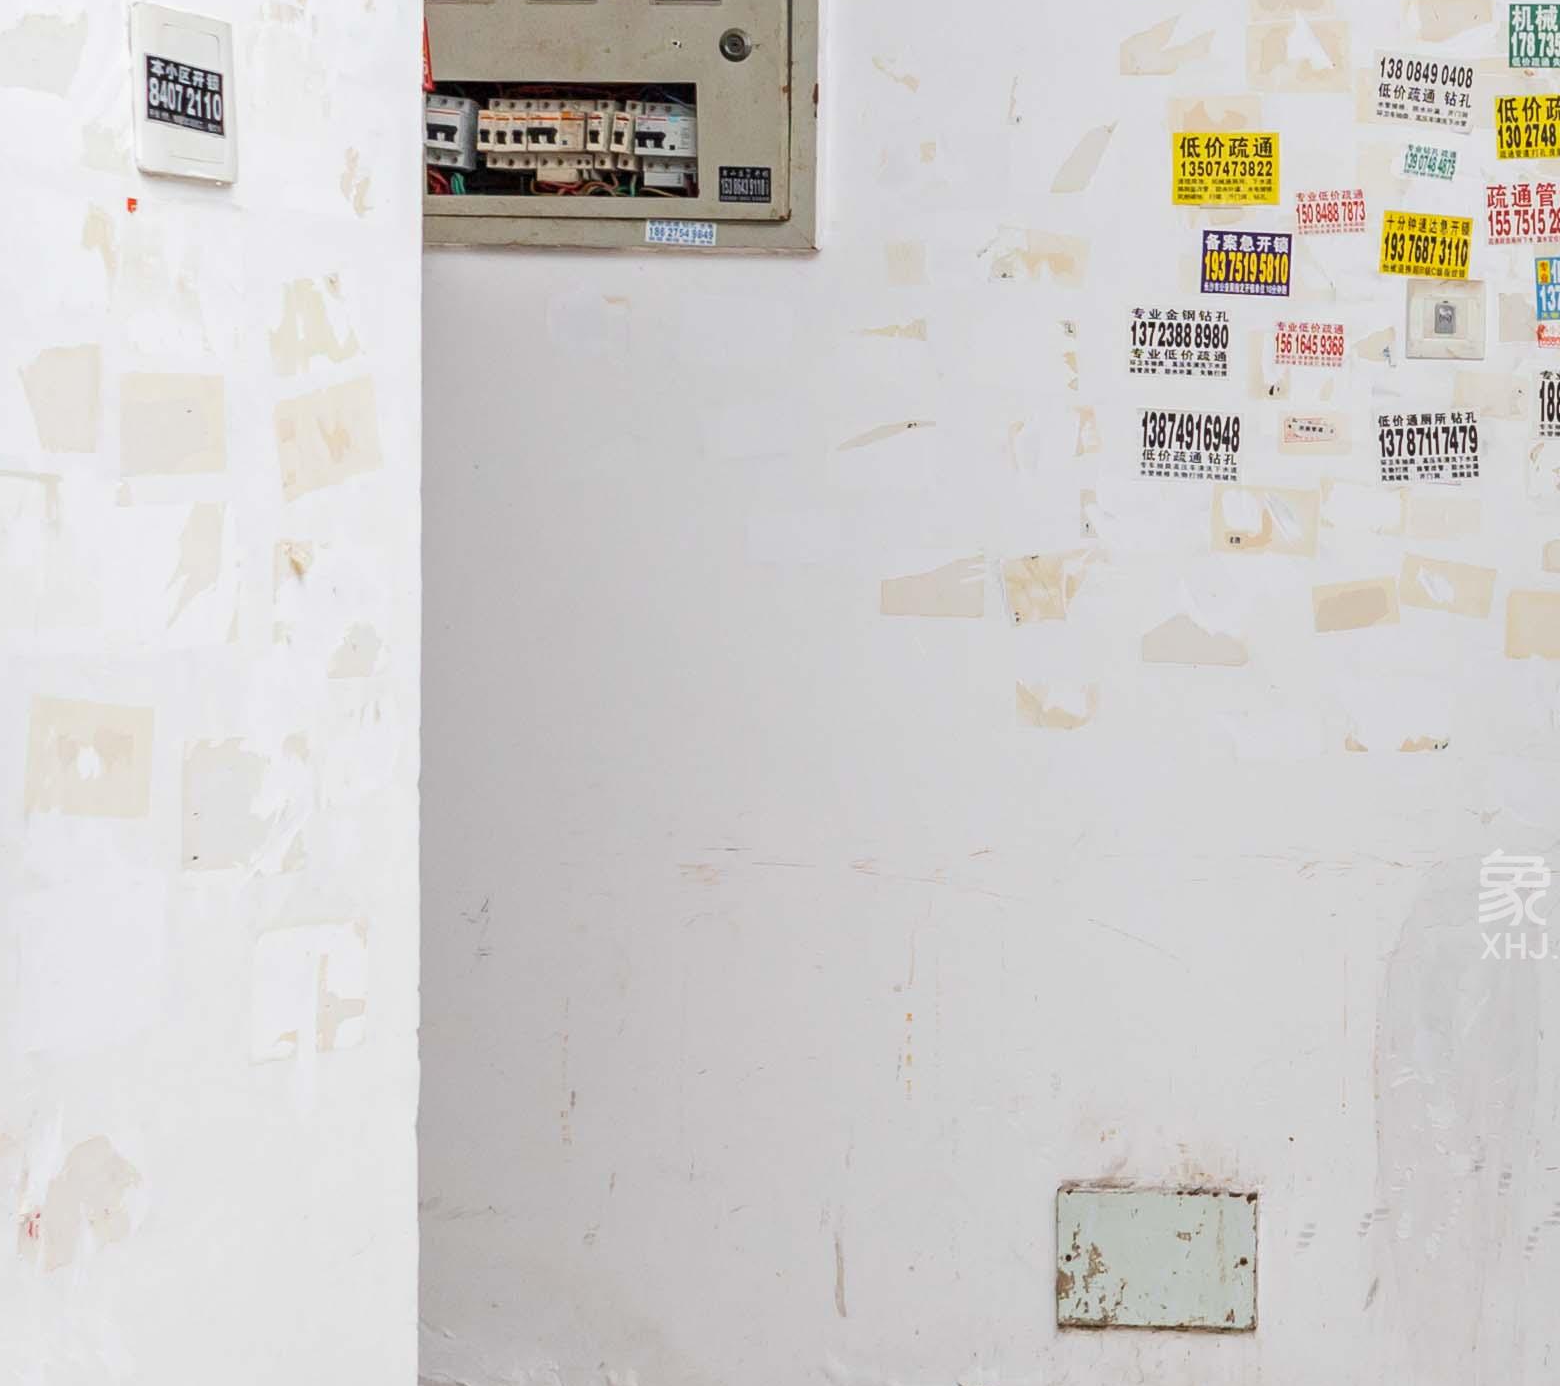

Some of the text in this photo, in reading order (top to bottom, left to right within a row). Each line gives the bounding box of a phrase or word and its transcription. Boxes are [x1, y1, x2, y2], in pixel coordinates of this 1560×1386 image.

[1510, 32, 1536, 58] 178
[149, 59, 220, 92] 本小区开锁
[1379, 57, 1474, 89] 138 0849 0408
[148, 76, 223, 122] 8407 2110
[1378, 82, 1472, 110] 低价疏通 钻孔
[1179, 136, 1274, 159] 低价疏通
[1497, 125, 1522, 149] 130
[1524, 123, 1557, 148] 2748
[1180, 160, 1274, 177] 13507473822
[1295, 188, 1365, 202] 专业低价疏通
[1295, 200, 1366, 224] 150 8488 7873
[1487, 209, 1511, 237] 155
[1514, 208, 1547, 236] 7515
[1205, 233, 1290, 254] 备案急开锁
[1383, 231, 1469, 268] 193 7687 3110
[1204, 251, 1289, 284] 193 7519 5810
[1131, 307, 1230, 322] 专业金钢钻孔
[1130, 321, 1230, 350] 137 2388 8980
[1276, 321, 1345, 335] 专业低价疏通
[1130, 348, 1228, 362] 专业低价疏通
[1274, 332, 1345, 357] 156 1645 9368
[1378, 411, 1478, 427] 低价通厕所 钻孔
[1142, 411, 1240, 454] 13874916948
[1379, 427, 1405, 458] 137
[1142, 449, 1237, 466] 低价疏通 钻孔
